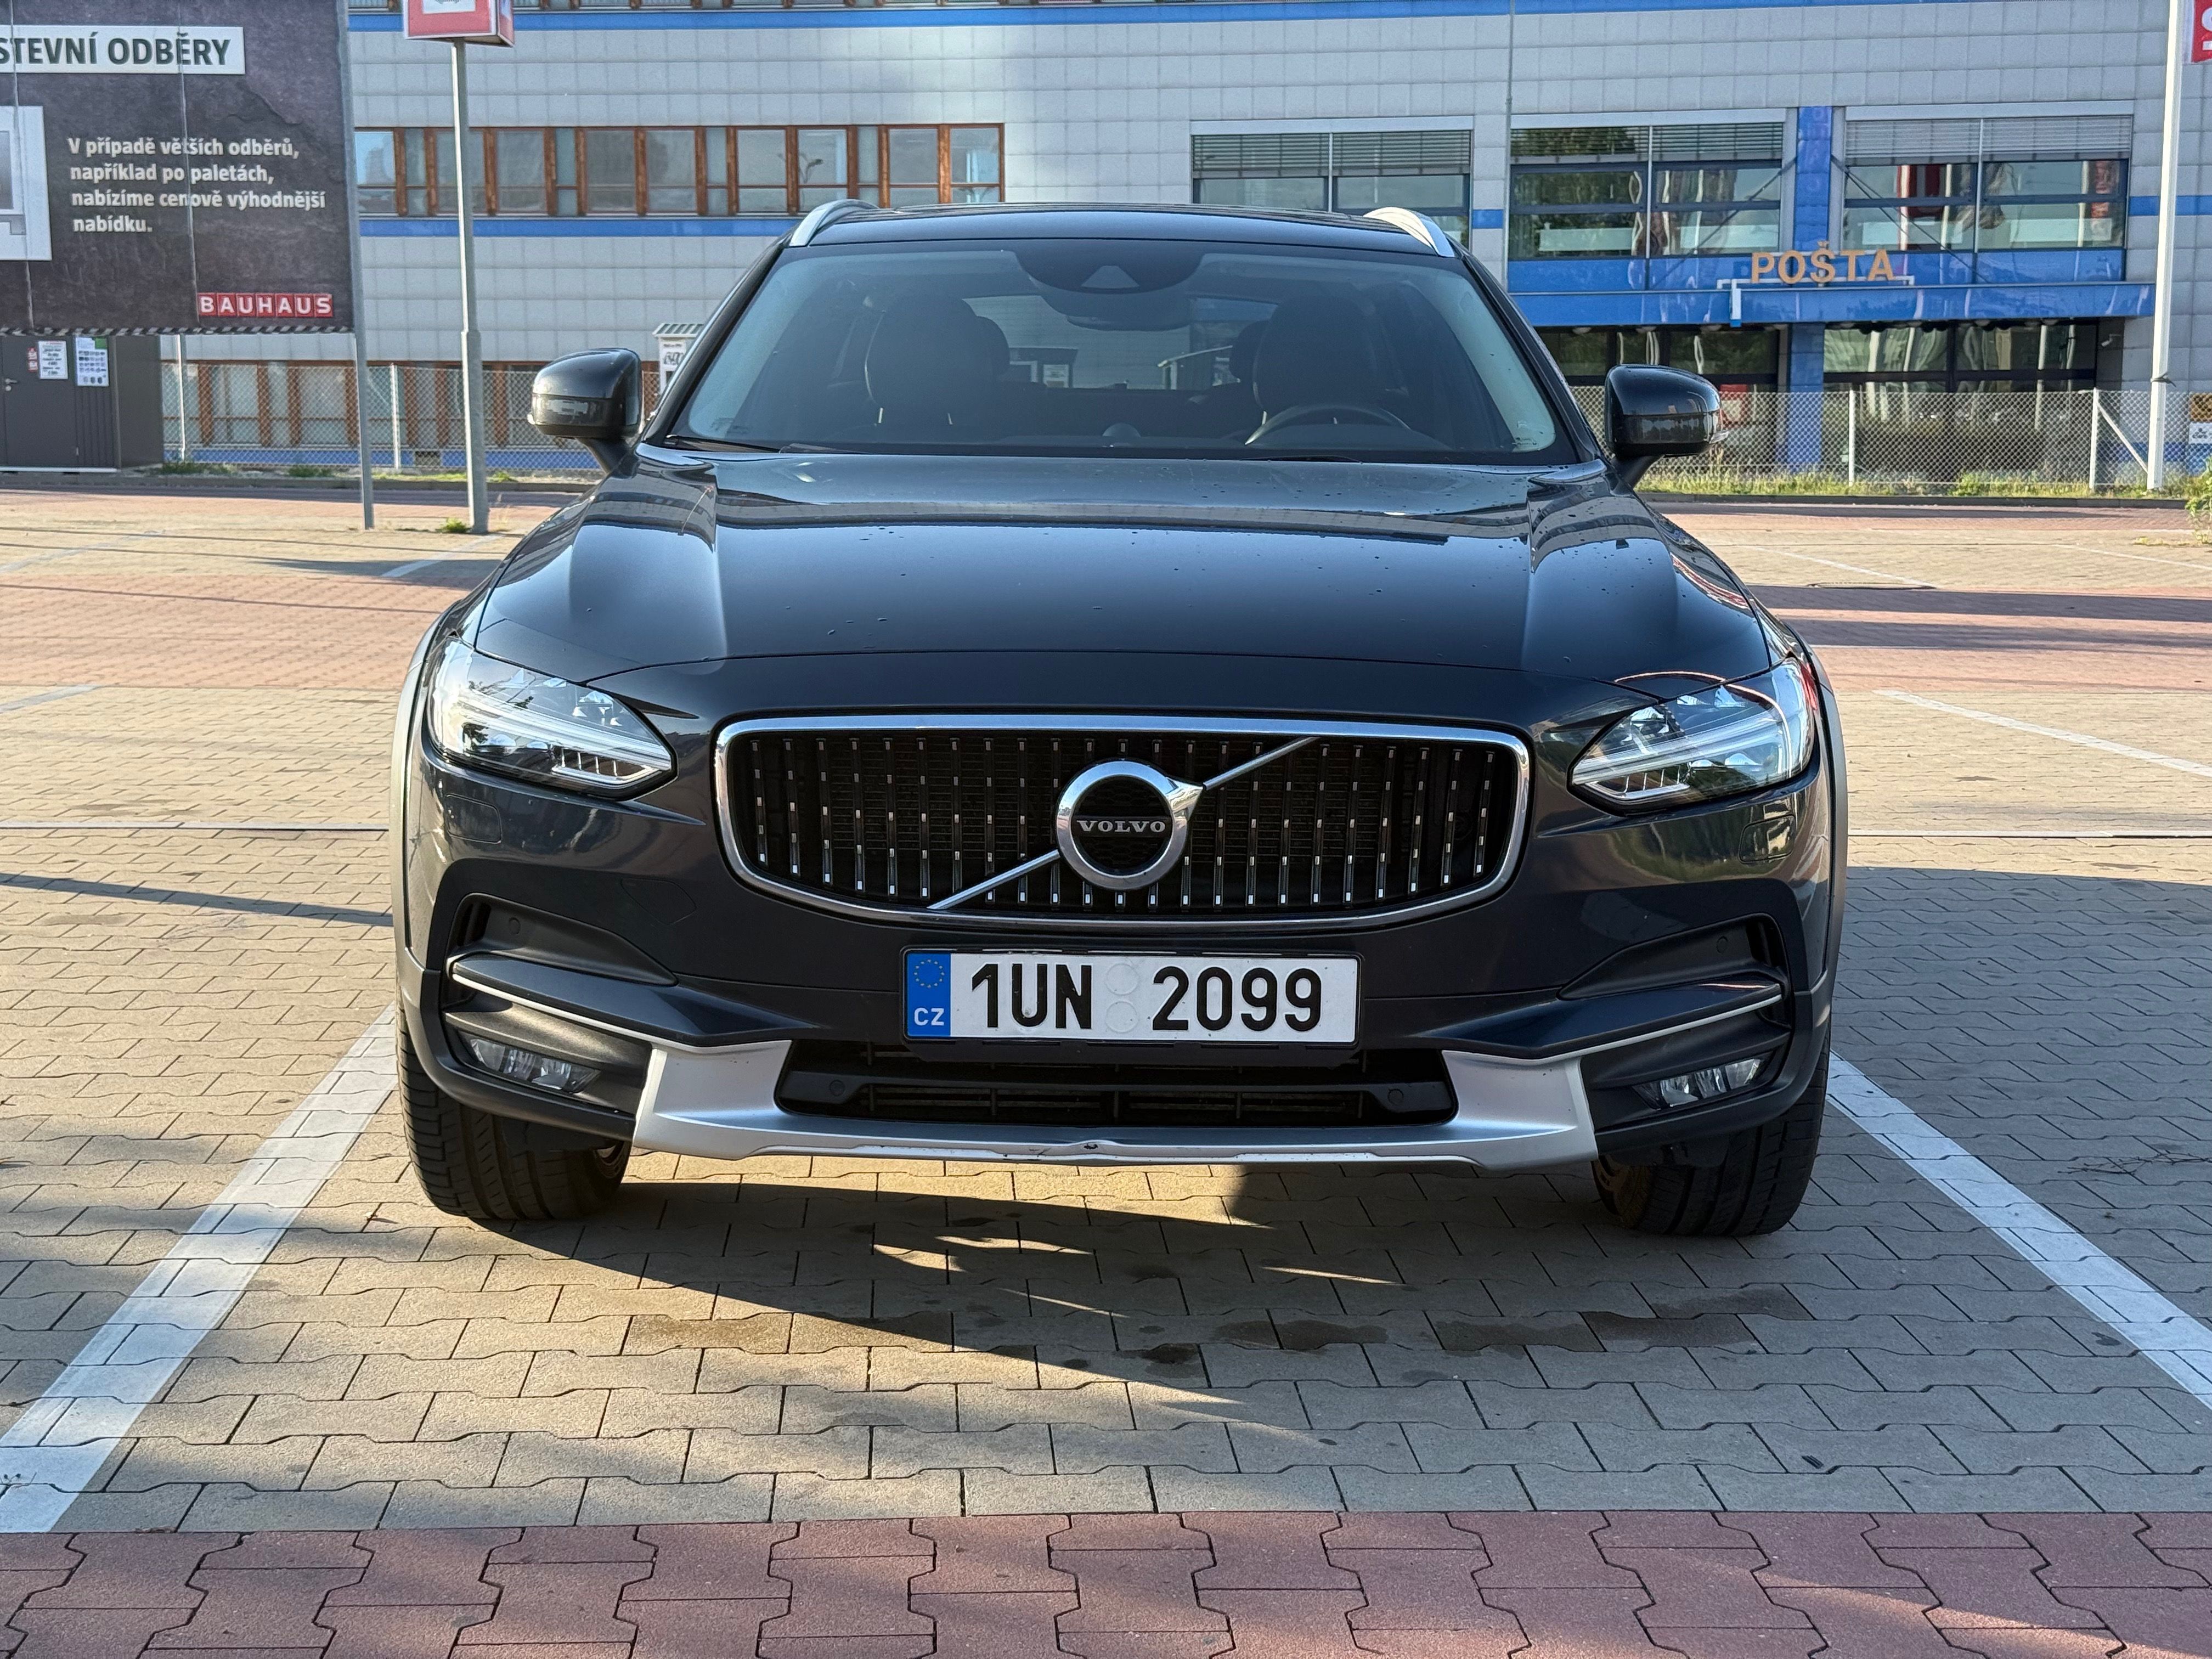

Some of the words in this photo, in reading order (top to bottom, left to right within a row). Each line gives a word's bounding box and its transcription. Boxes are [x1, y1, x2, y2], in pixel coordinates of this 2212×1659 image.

[108, 32, 231, 65] ODBĚRY
[68, 138, 81, 154] V
[86, 137, 156, 158] případě
[160, 137, 223, 155] větších
[229, 137, 300, 159] odběrů,
[70, 163, 157, 183] například
[162, 168, 185, 183] po
[190, 164, 274, 184] paletách,
[72, 190, 154, 207] nabízíme
[159, 191, 222, 208] cenově
[227, 190, 326, 210] výhodnější
[73, 216, 153, 233] nabídku.
[1751, 240, 1894, 284] POŠTA
[200, 296, 332, 314] BAUHAUS
[1077, 820, 1166, 832] VOLVO
[972, 963, 1092, 1030] 1UN
[1153, 966, 1322, 1032] 2099
[913, 1007, 945, 1027] CZ
